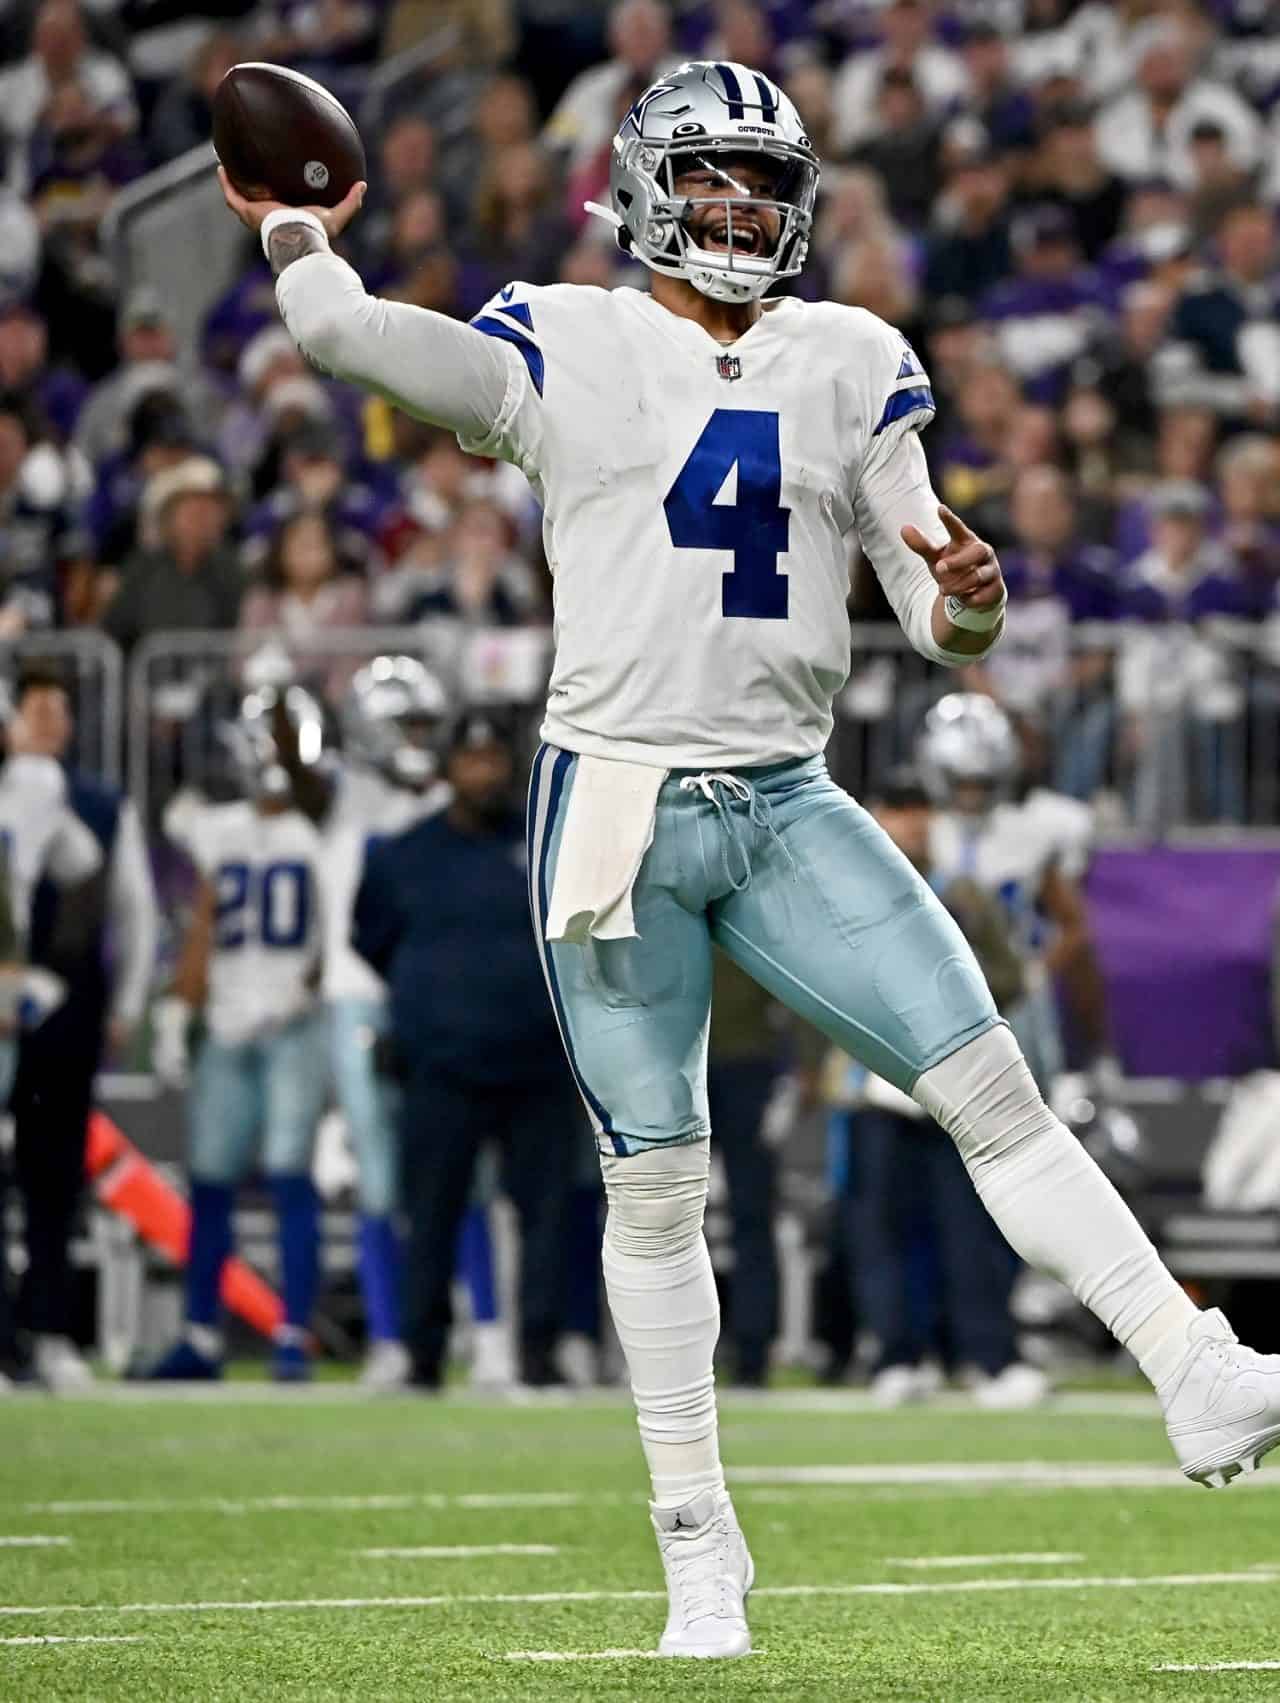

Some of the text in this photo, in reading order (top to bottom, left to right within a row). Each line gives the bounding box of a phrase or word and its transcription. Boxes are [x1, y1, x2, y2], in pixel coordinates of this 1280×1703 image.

[737, 125, 776, 137] COWBOYS
[662, 407, 792, 620] 4
[213, 861, 310, 947] 20
